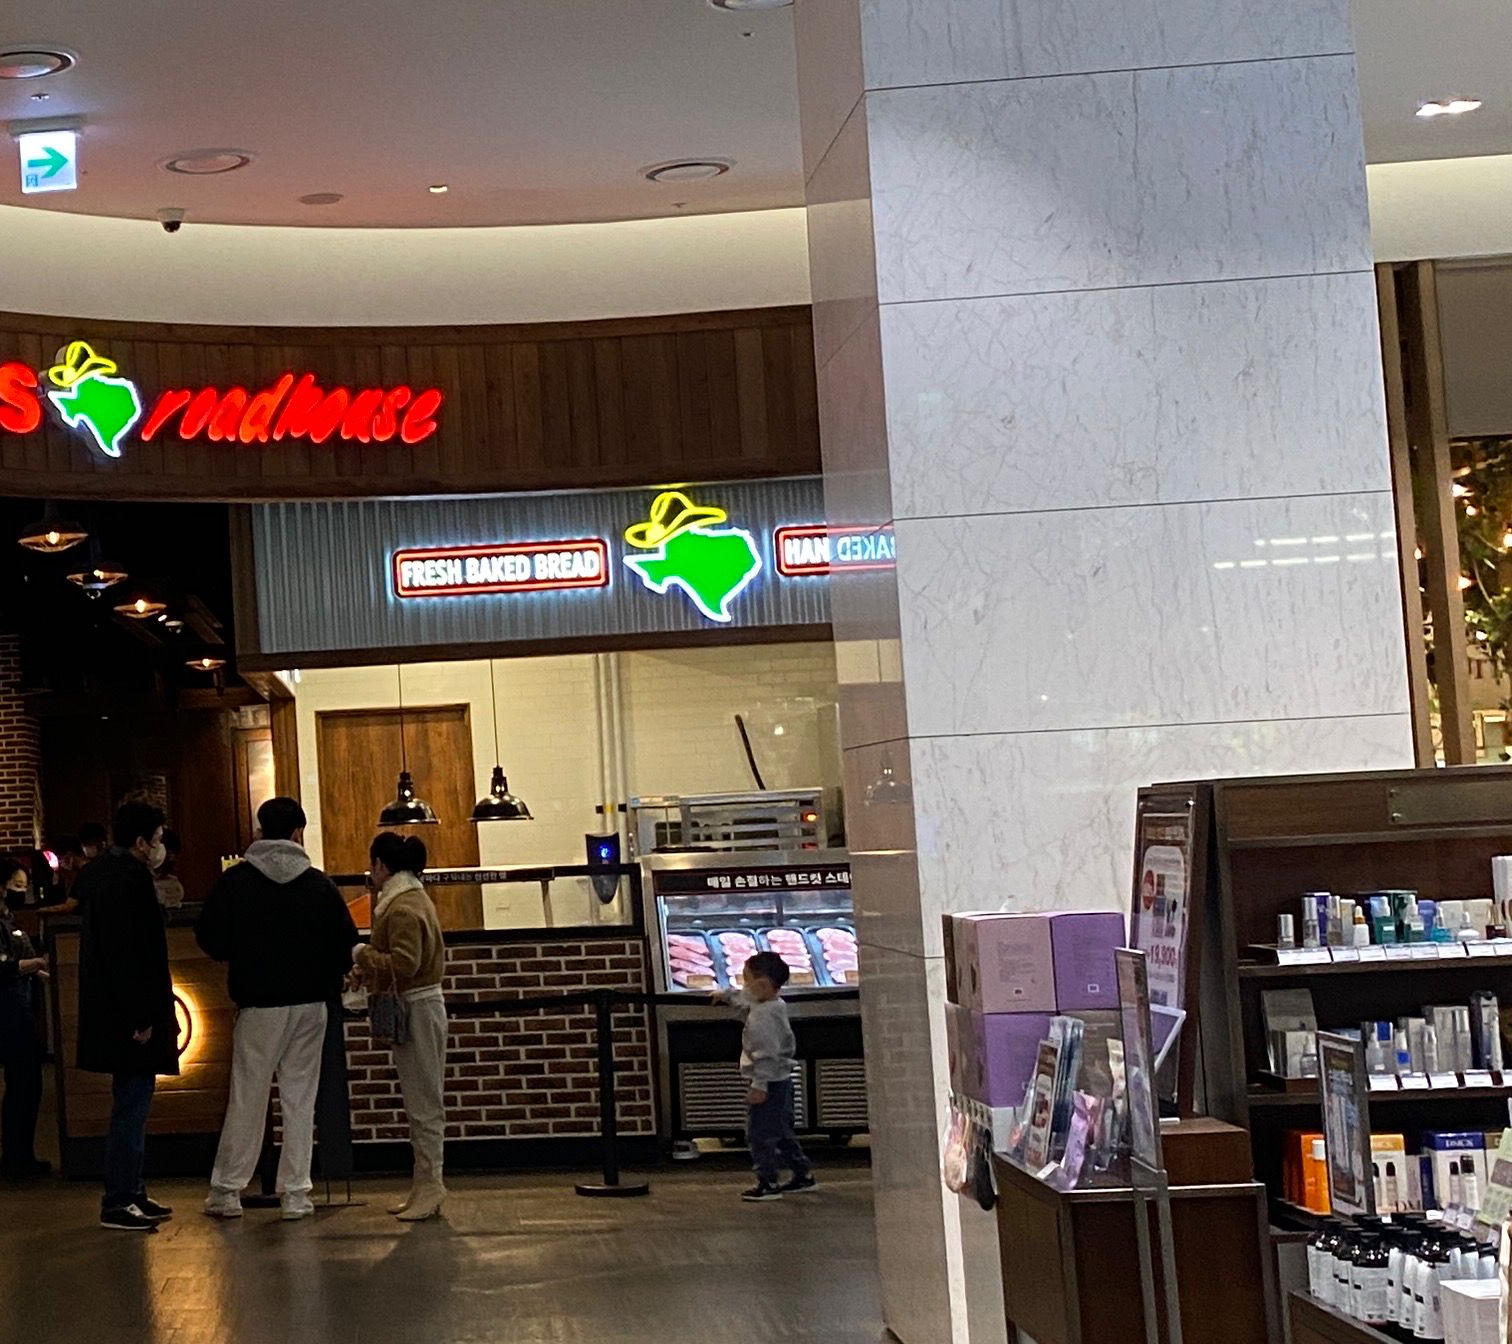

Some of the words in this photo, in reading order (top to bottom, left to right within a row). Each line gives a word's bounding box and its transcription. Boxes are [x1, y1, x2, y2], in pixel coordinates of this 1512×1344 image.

[141, 372, 443, 445] roadhouse
[400, 559, 463, 588] FRESH
[466, 554, 531, 585] BAKED
[534, 550, 600, 580] BREAD
[706, 875, 731, 888] 매일
[825, 871, 852, 884] 스테
